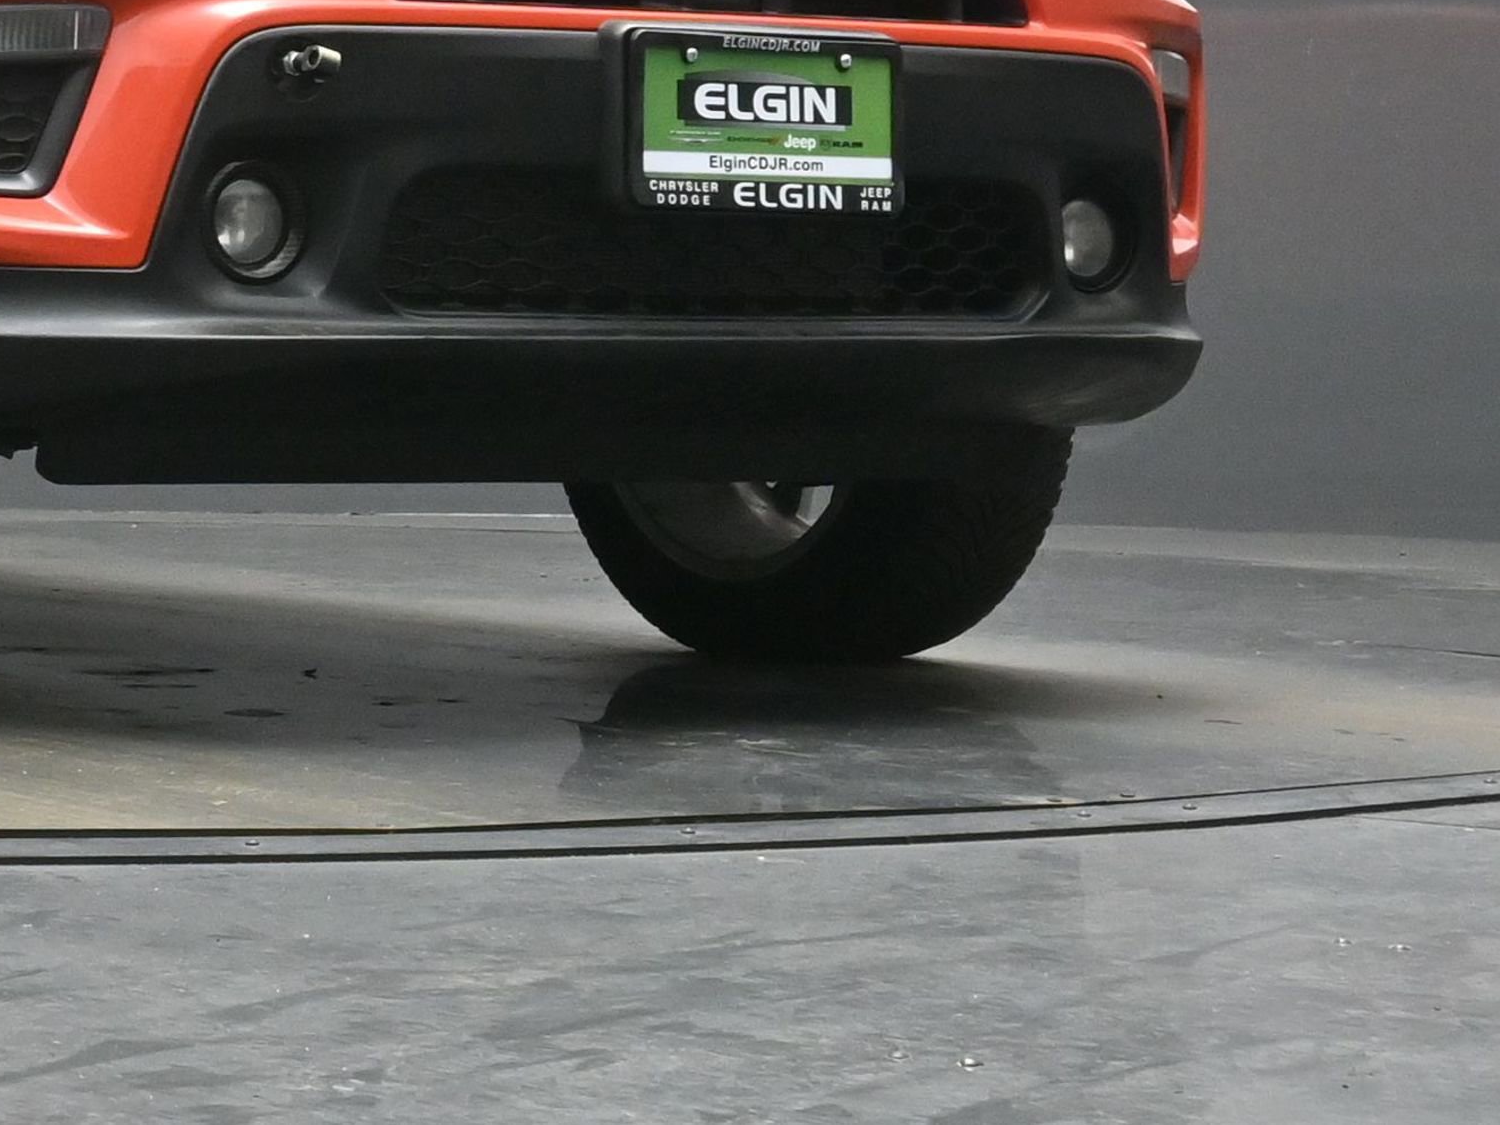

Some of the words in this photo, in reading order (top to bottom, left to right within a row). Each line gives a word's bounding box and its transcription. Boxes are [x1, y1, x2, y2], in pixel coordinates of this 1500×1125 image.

[722, 35, 820, 54] ELGINCDJR.COM
[693, 82, 837, 124] ELGIN
[784, 133, 817, 152] Jeep
[709, 155, 824, 172] ElginCDJR.com
[649, 179, 719, 193] CHRYSLER
[860, 187, 892, 199] JEEP
[656, 193, 711, 206] DODGE
[733, 181, 844, 211] ELGIN
[860, 200, 893, 212] RAM
